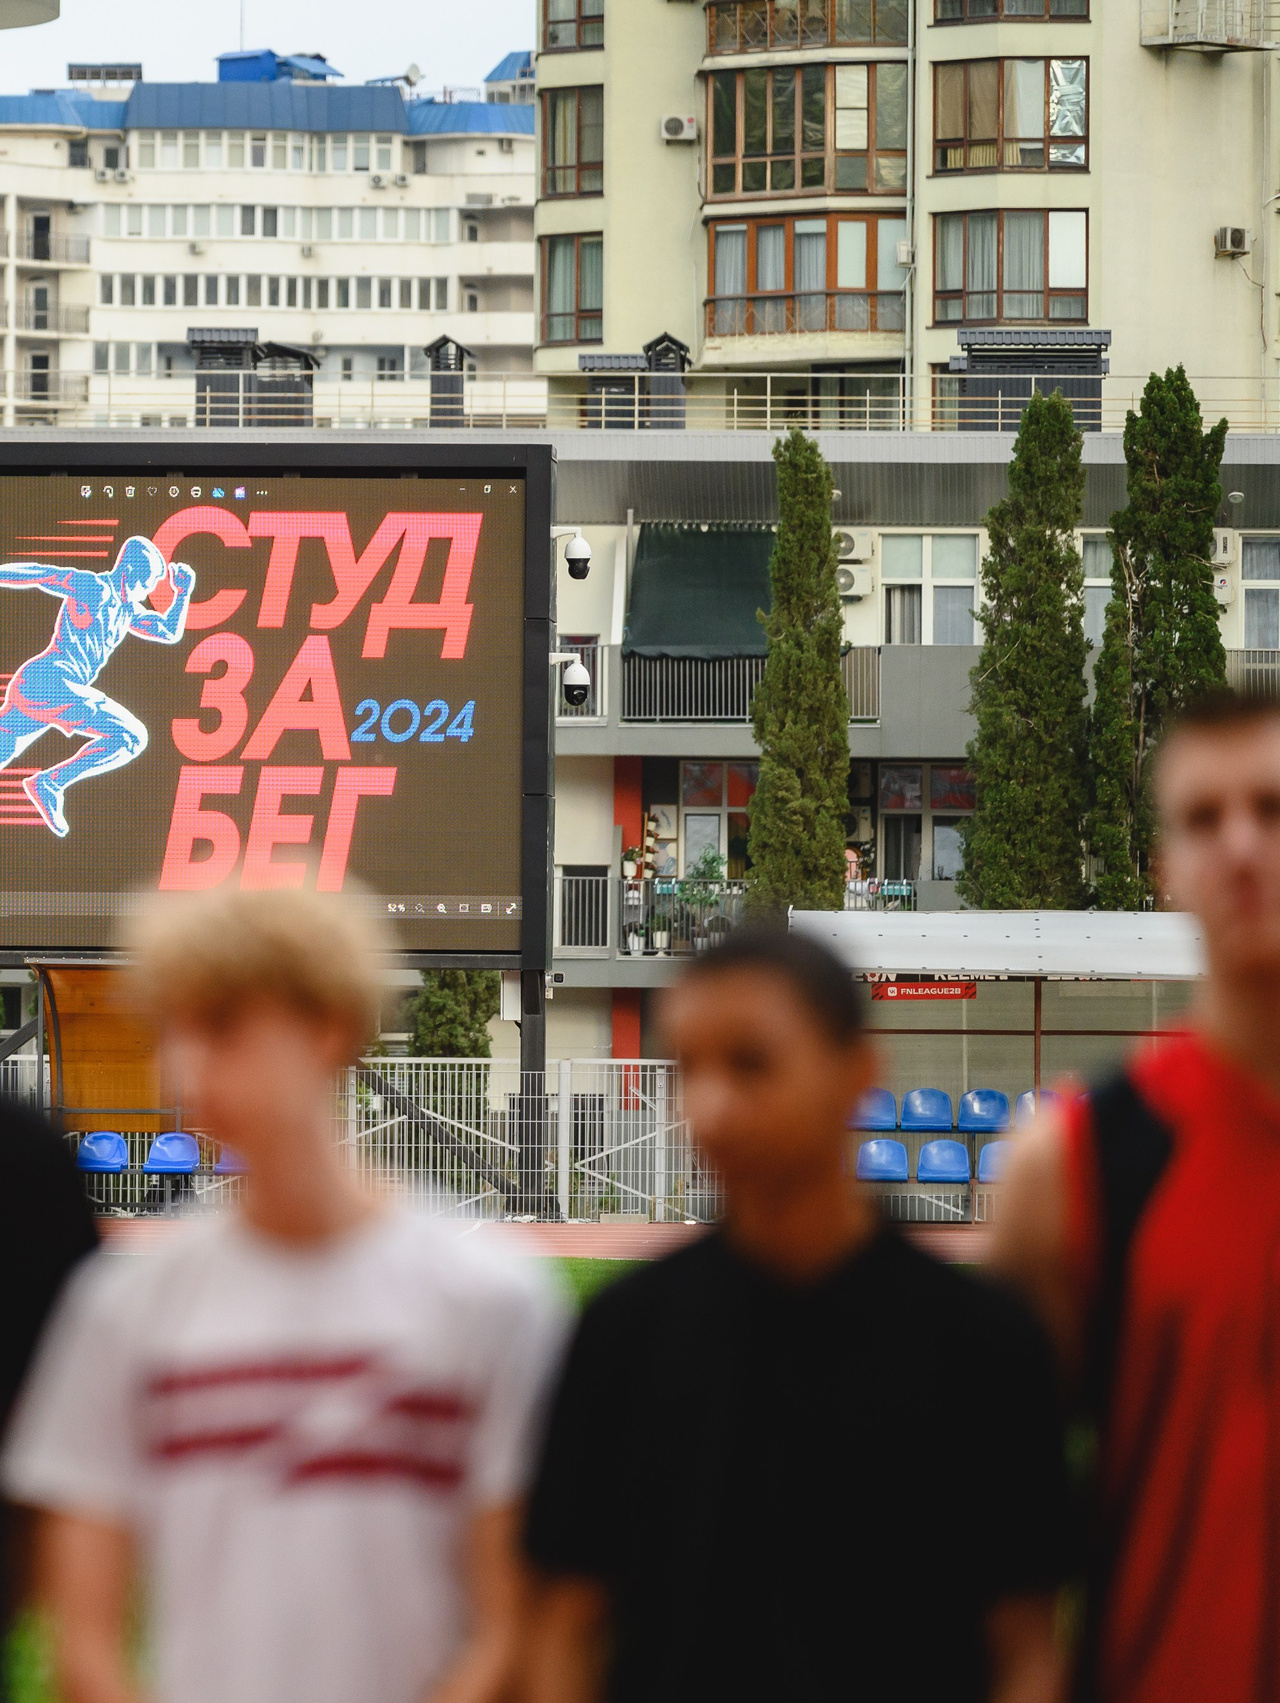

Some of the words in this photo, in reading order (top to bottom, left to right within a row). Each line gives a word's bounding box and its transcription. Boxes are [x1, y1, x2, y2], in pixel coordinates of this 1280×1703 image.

[148, 505, 483, 659] СТУД
[171, 632, 352, 762] ЗА
[351, 699, 475, 743] 2024
[158, 765, 397, 892] БЕГ
